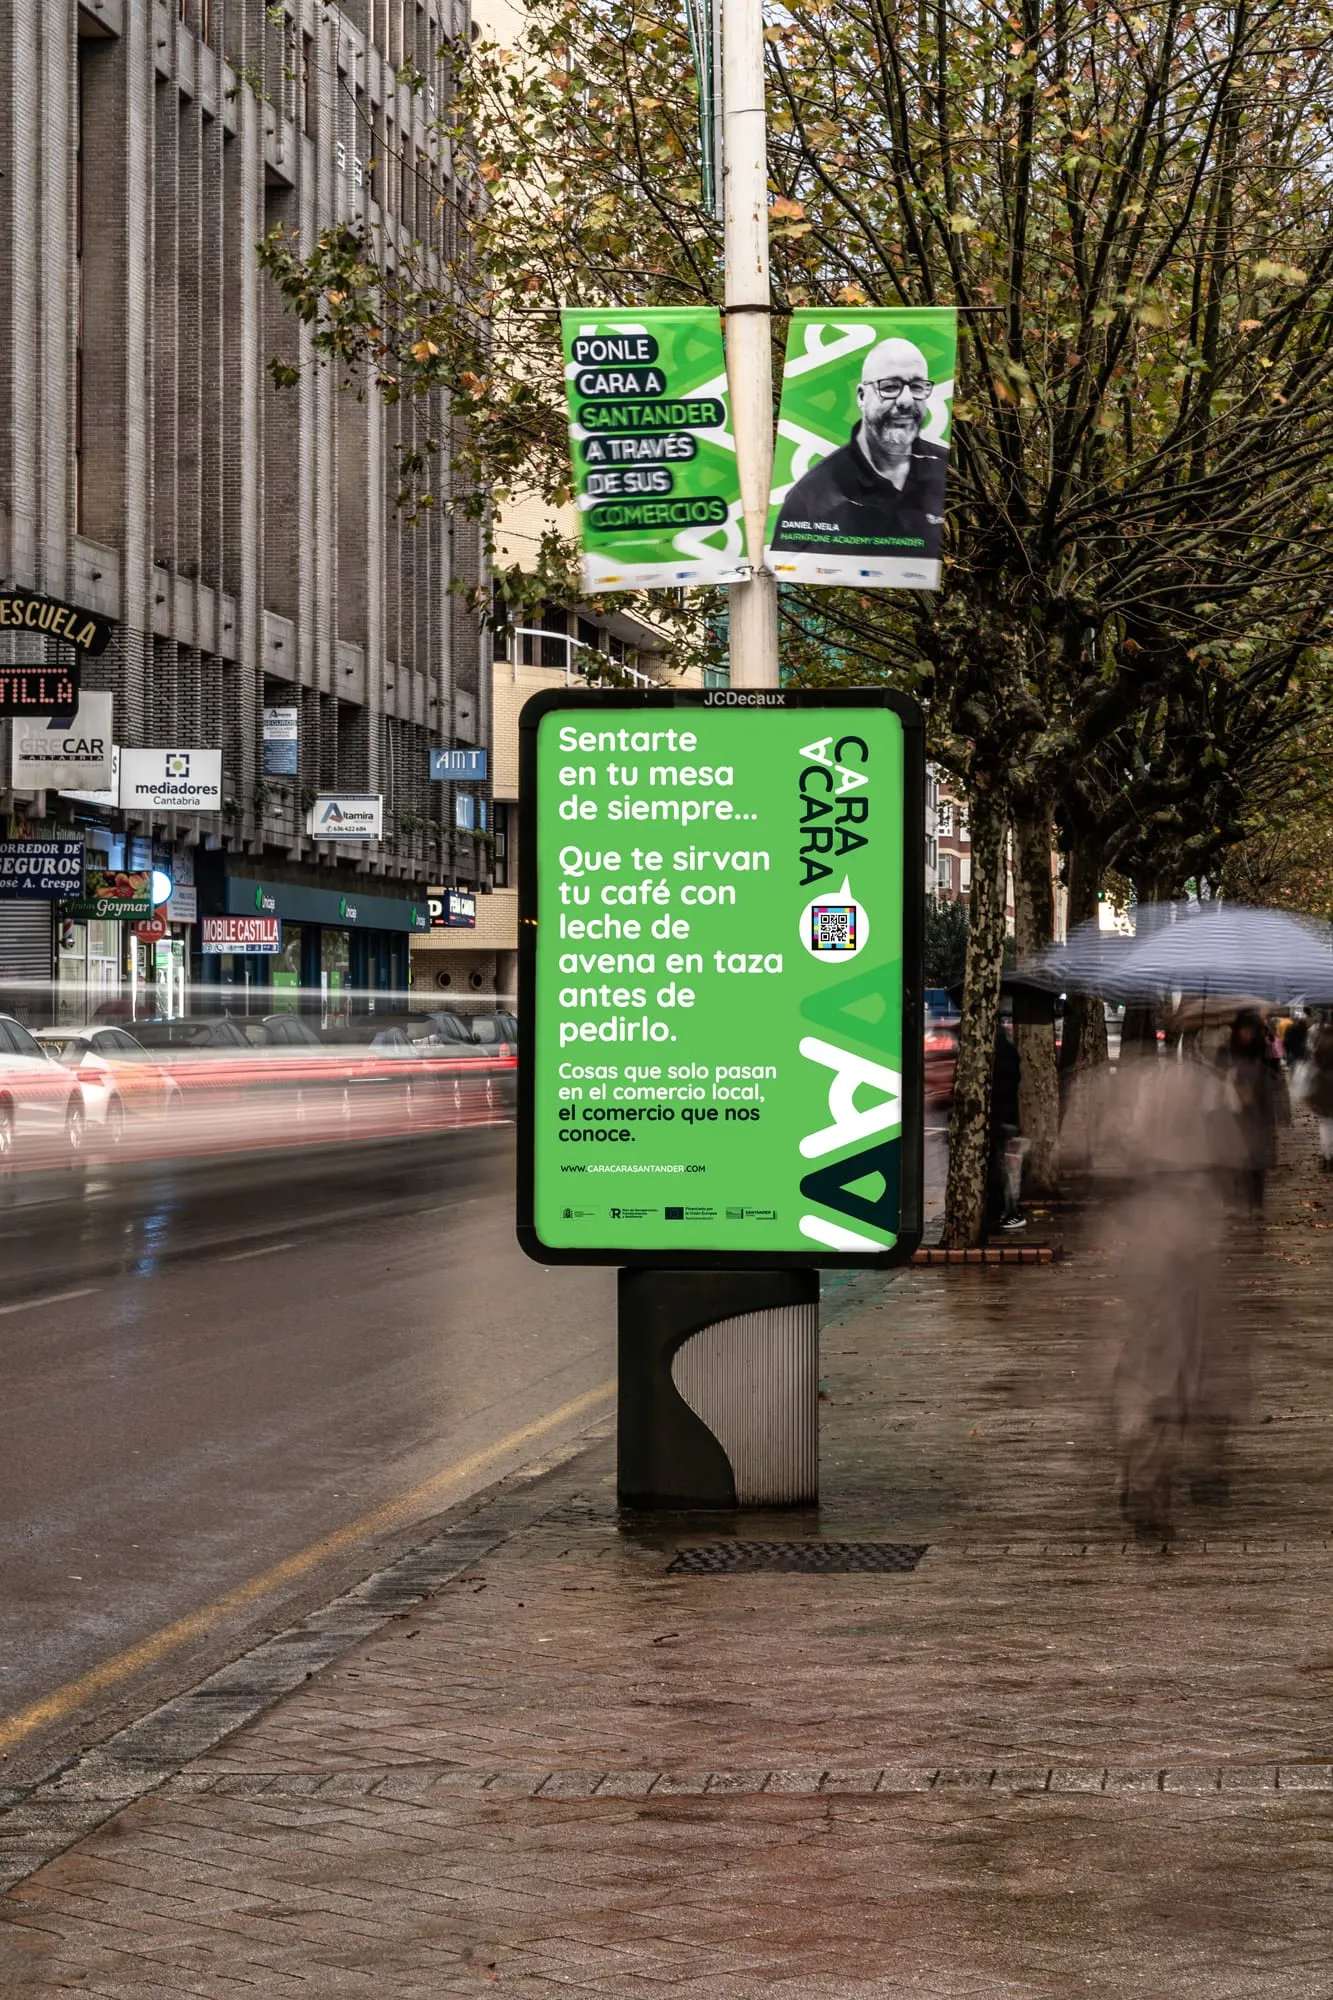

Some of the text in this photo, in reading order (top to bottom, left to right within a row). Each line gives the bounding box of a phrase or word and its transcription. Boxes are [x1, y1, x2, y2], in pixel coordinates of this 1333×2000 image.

[576, 339, 650, 361] PONLE
[579, 372, 662, 394] CARA A
[582, 403, 718, 428] SANTANDER
[585, 433, 695, 461] A TRAVÉS
[587, 471, 671, 495] DE SUS
[590, 501, 725, 527] COMERCIOS
[782, 520, 840, 532] DANIEL NEILA
[832, 535, 871, 545] ACADEMY
[872, 536, 925, 547] SANTANDER
[704, 691, 786, 706] JCDecaux
[20, 739, 104, 754] GRECAR
[559, 726, 697, 752] Sentarte
[559, 763, 734, 786] en tu mesa
[135, 782, 218, 795] mediadores
[834, 735, 869, 857] CARA
[153, 796, 201, 806] Cantabria
[559, 794, 758, 826] de siempre...
[64, 843, 81, 855] DE
[0, 857, 81, 875] EGUROS
[559, 846, 771, 877] Que te sirvan
[23, 878, 36, 889] A.
[41, 878, 80, 892] Crespo
[559, 878, 736, 905] tu café con
[96, 899, 150, 917] Goymar
[203, 919, 279, 941] MOBILE CASTILLA
[559, 913, 690, 940] leche de
[559, 949, 784, 974] avena en taza
[559, 981, 696, 1008] antes de
[559, 1016, 677, 1048] pedirlo.
[558, 1062, 778, 1084] Cosas que solo pasan
[558, 1083, 766, 1104] en el comercio local,
[558, 1104, 761, 1126] el comercio que nos
[558, 1127, 637, 1142] conoce.
[560, 1164, 706, 1174] WWW.CARACARASANTANDER.COM
